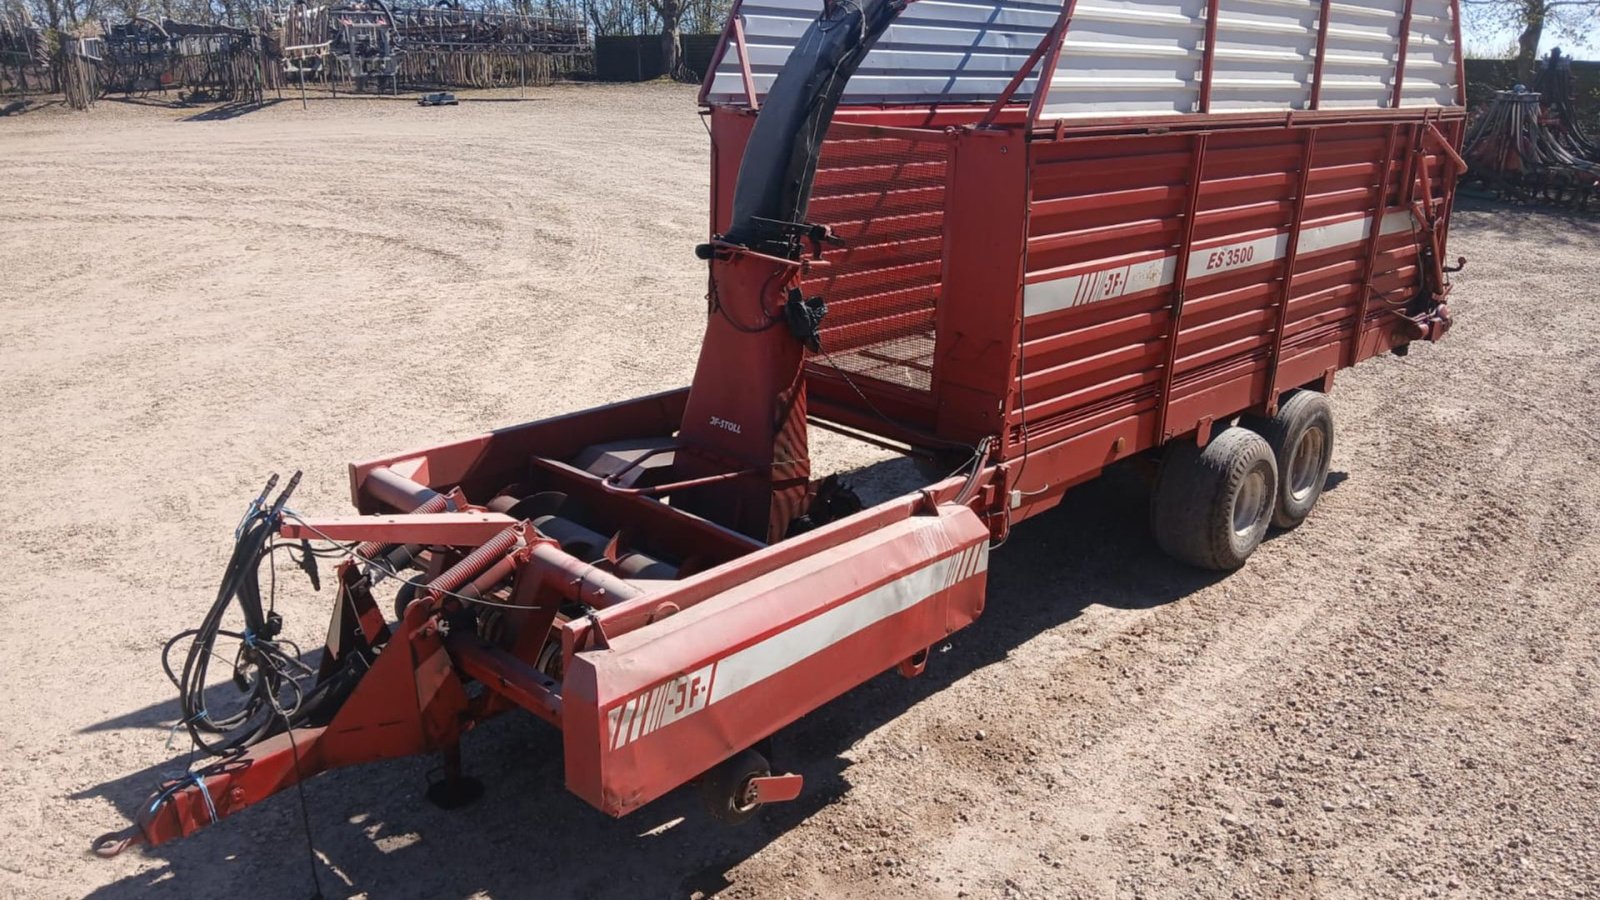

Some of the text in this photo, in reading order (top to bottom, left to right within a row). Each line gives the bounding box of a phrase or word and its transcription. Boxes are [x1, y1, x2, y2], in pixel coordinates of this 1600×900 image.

[1206, 245, 1253, 270] ES 3500
[709, 416, 741, 434] JF-STOLL
